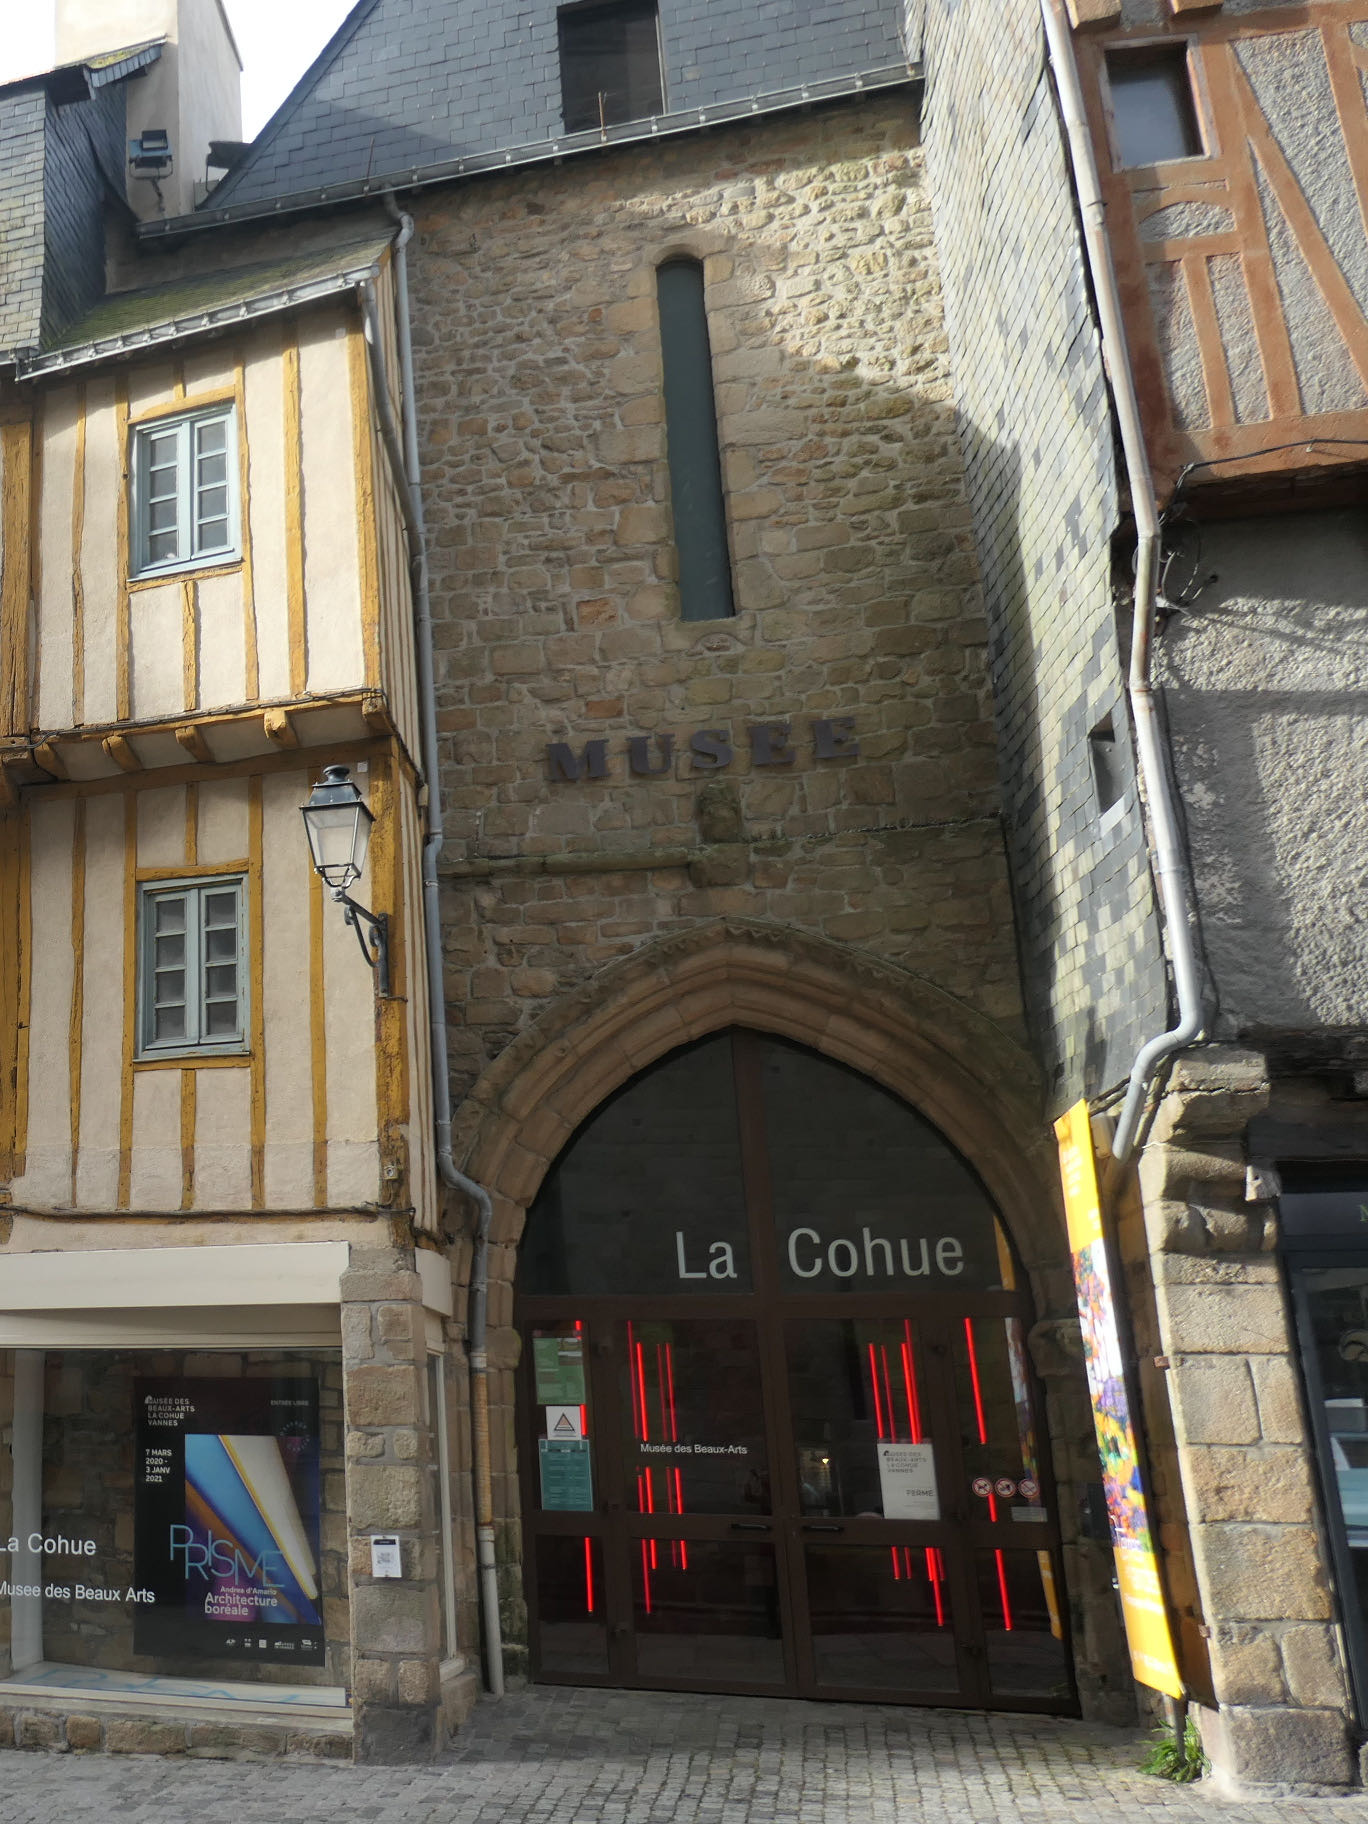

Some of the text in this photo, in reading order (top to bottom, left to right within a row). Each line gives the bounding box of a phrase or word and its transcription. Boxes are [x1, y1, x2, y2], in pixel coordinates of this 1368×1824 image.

[546, 717, 860, 783] MUSEE
[675, 1226, 964, 1280] La Cohue
[147, 1405, 195, 1413] BEAUX-ARTS
[151, 1449, 173, 1457] MARS
[640, 1443, 748, 1455] Musée des Beaux-Arts
[145, 1457, 164, 1465] 2020
[151, 1466, 171, 1474] JANV
[27, 1533, 97, 1556] Cohue
[169, 1524, 285, 1588] PRISME
[44, 1583, 71, 1599] des
[75, 1584, 122, 1602] Beaux
[125, 1587, 156, 1604] Arts
[220, 1586, 245, 1594] Andrea
[205, 1592, 278, 1607] Architecture
[204, 1602, 249, 1616] boréale
